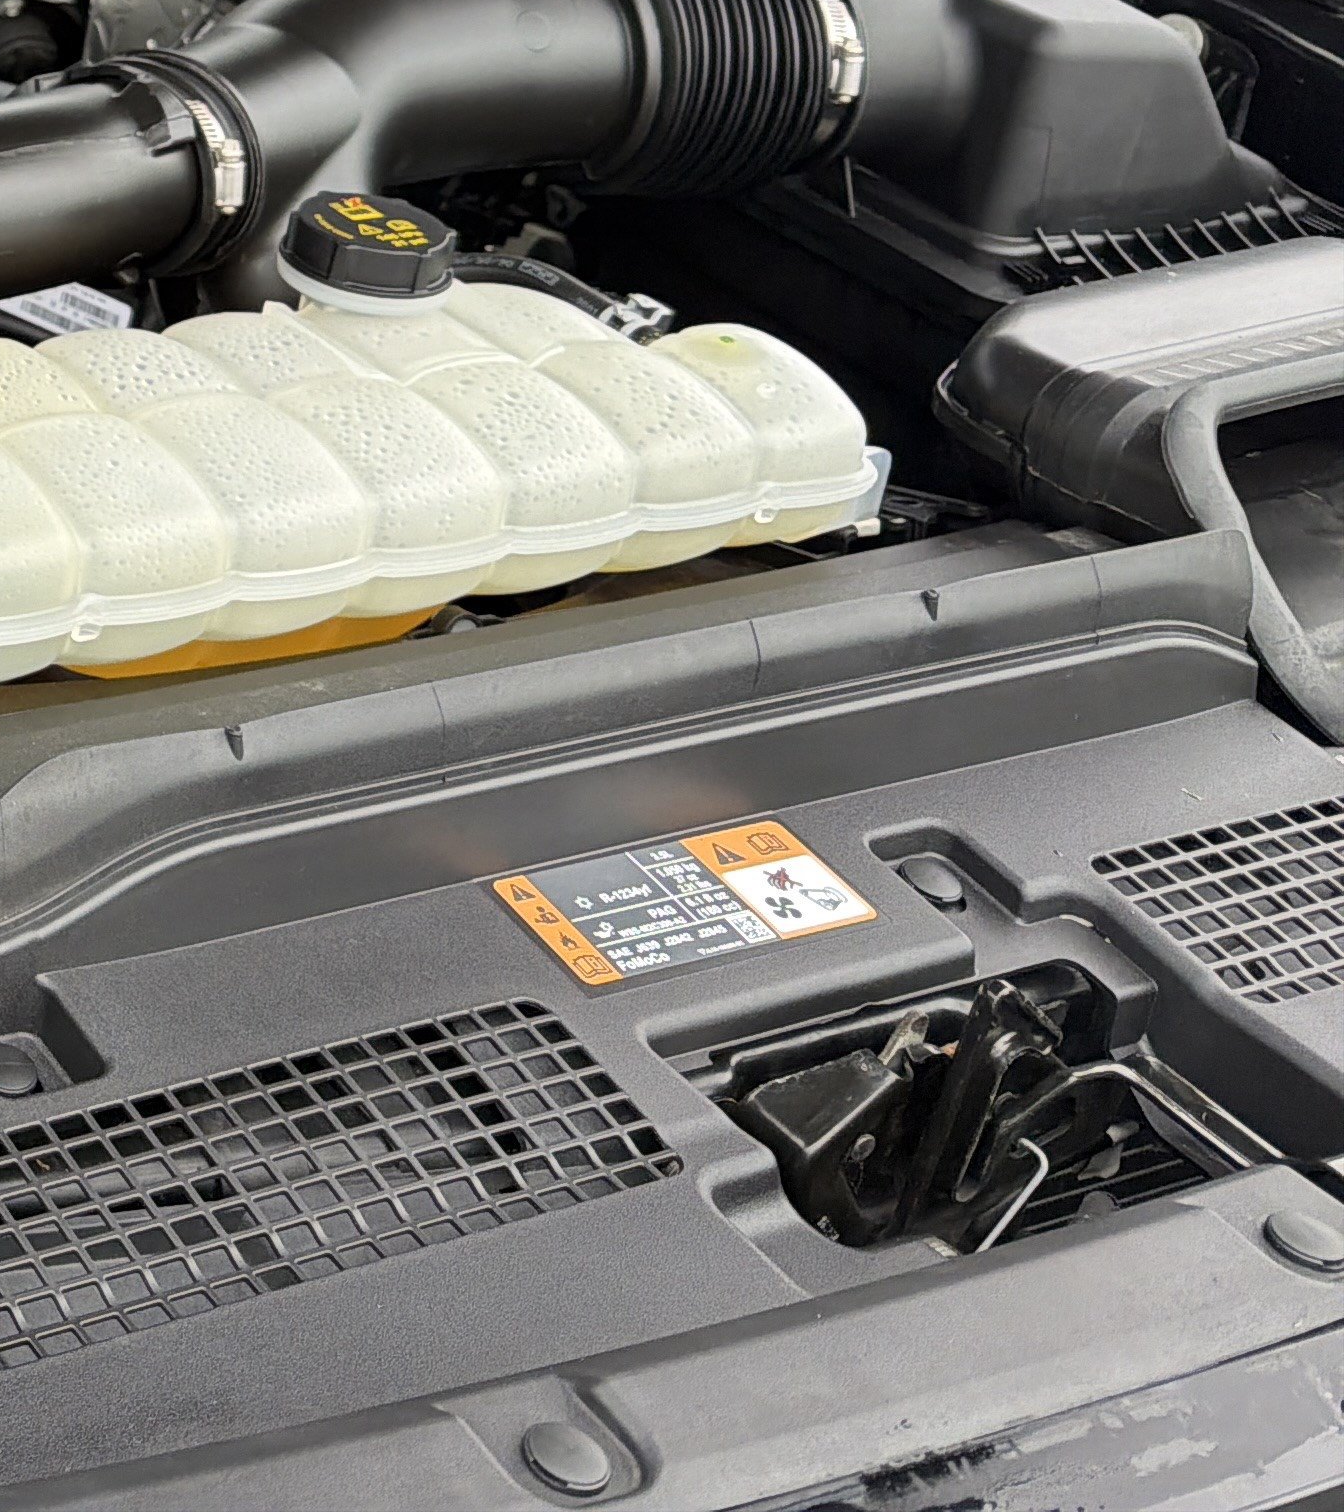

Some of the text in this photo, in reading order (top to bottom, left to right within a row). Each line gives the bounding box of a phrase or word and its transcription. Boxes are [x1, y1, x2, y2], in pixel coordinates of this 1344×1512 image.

[598, 883, 653, 904] R-1234yf
[647, 904, 677, 919] PAG
[615, 953, 671, 972] FoMoCo
